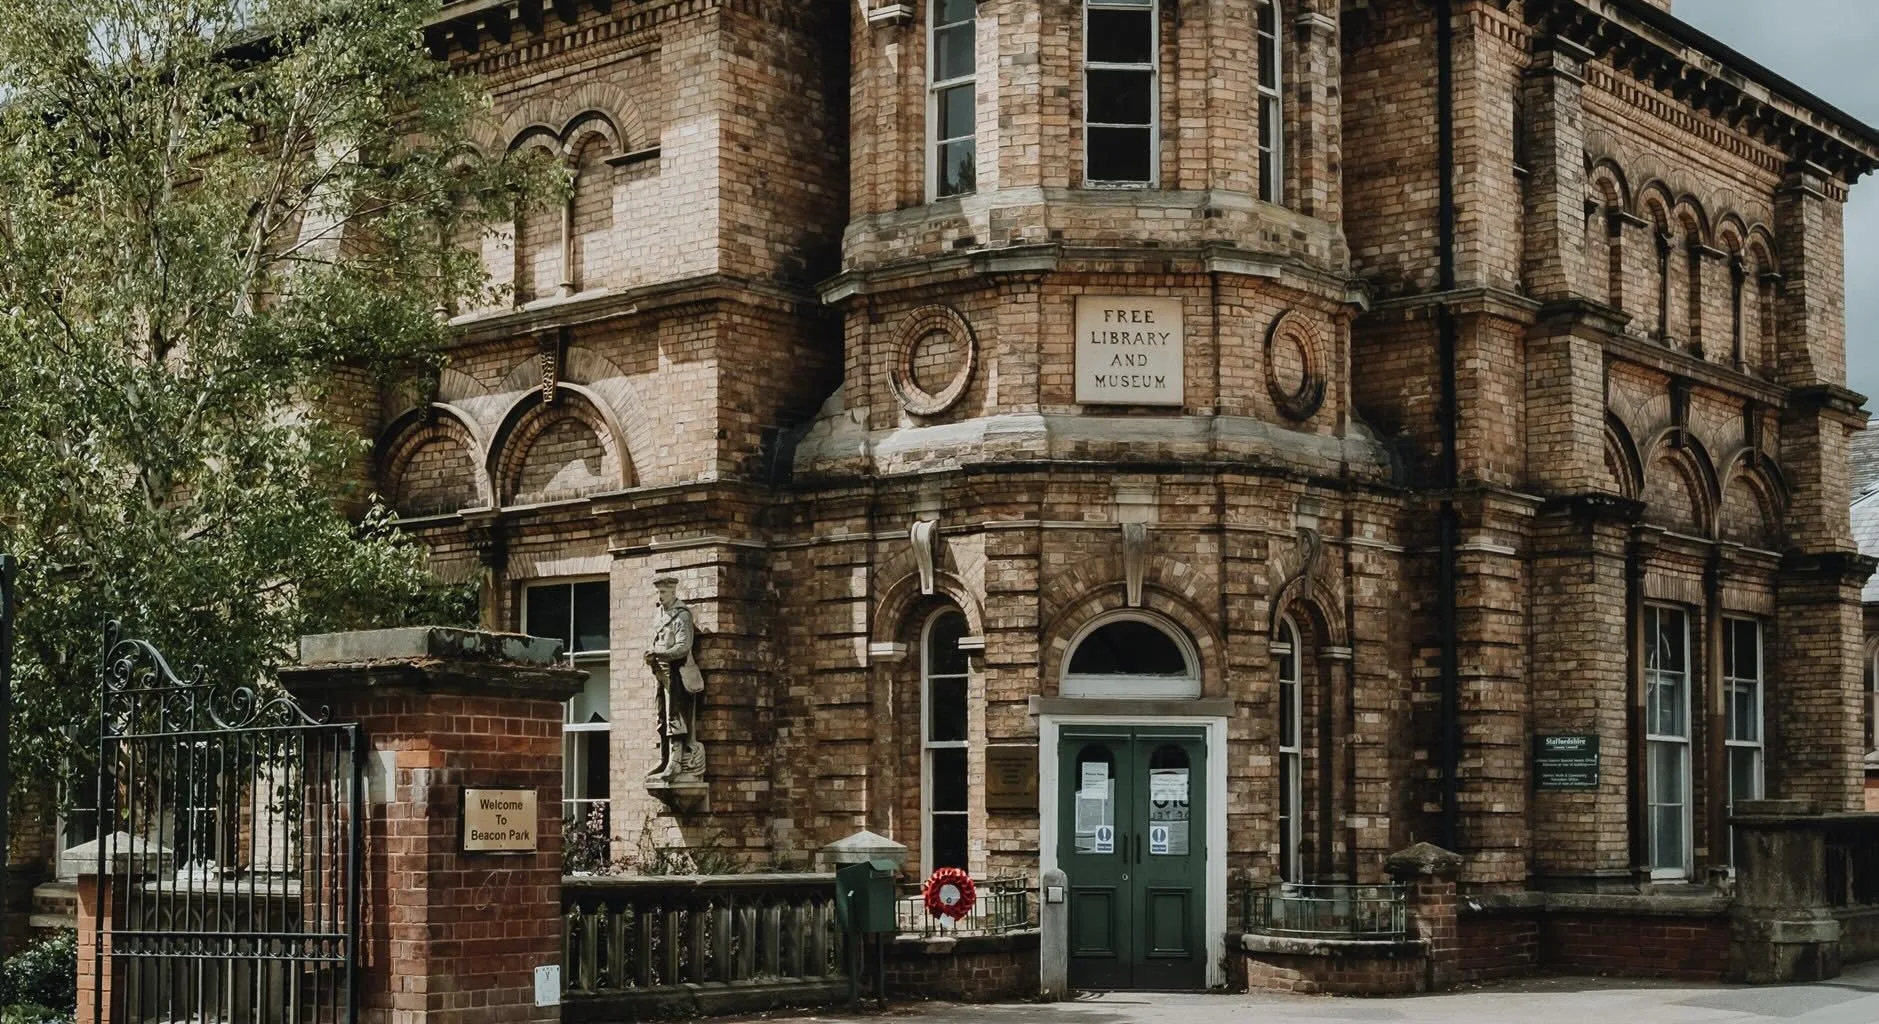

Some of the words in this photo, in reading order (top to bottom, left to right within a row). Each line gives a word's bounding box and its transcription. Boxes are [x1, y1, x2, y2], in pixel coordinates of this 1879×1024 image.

[1104, 309, 1155, 323] FREE
[1090, 331, 1170, 346] LIBRARY
[1110, 353, 1148, 367] AND
[1095, 375, 1166, 388] MUSEUM
[1545, 737, 1586, 745] Staffordshire
[480, 799, 523, 810] Welcome
[495, 814, 508, 825] To
[471, 830, 507, 841] Beacon
[509, 830, 530, 841] Park
